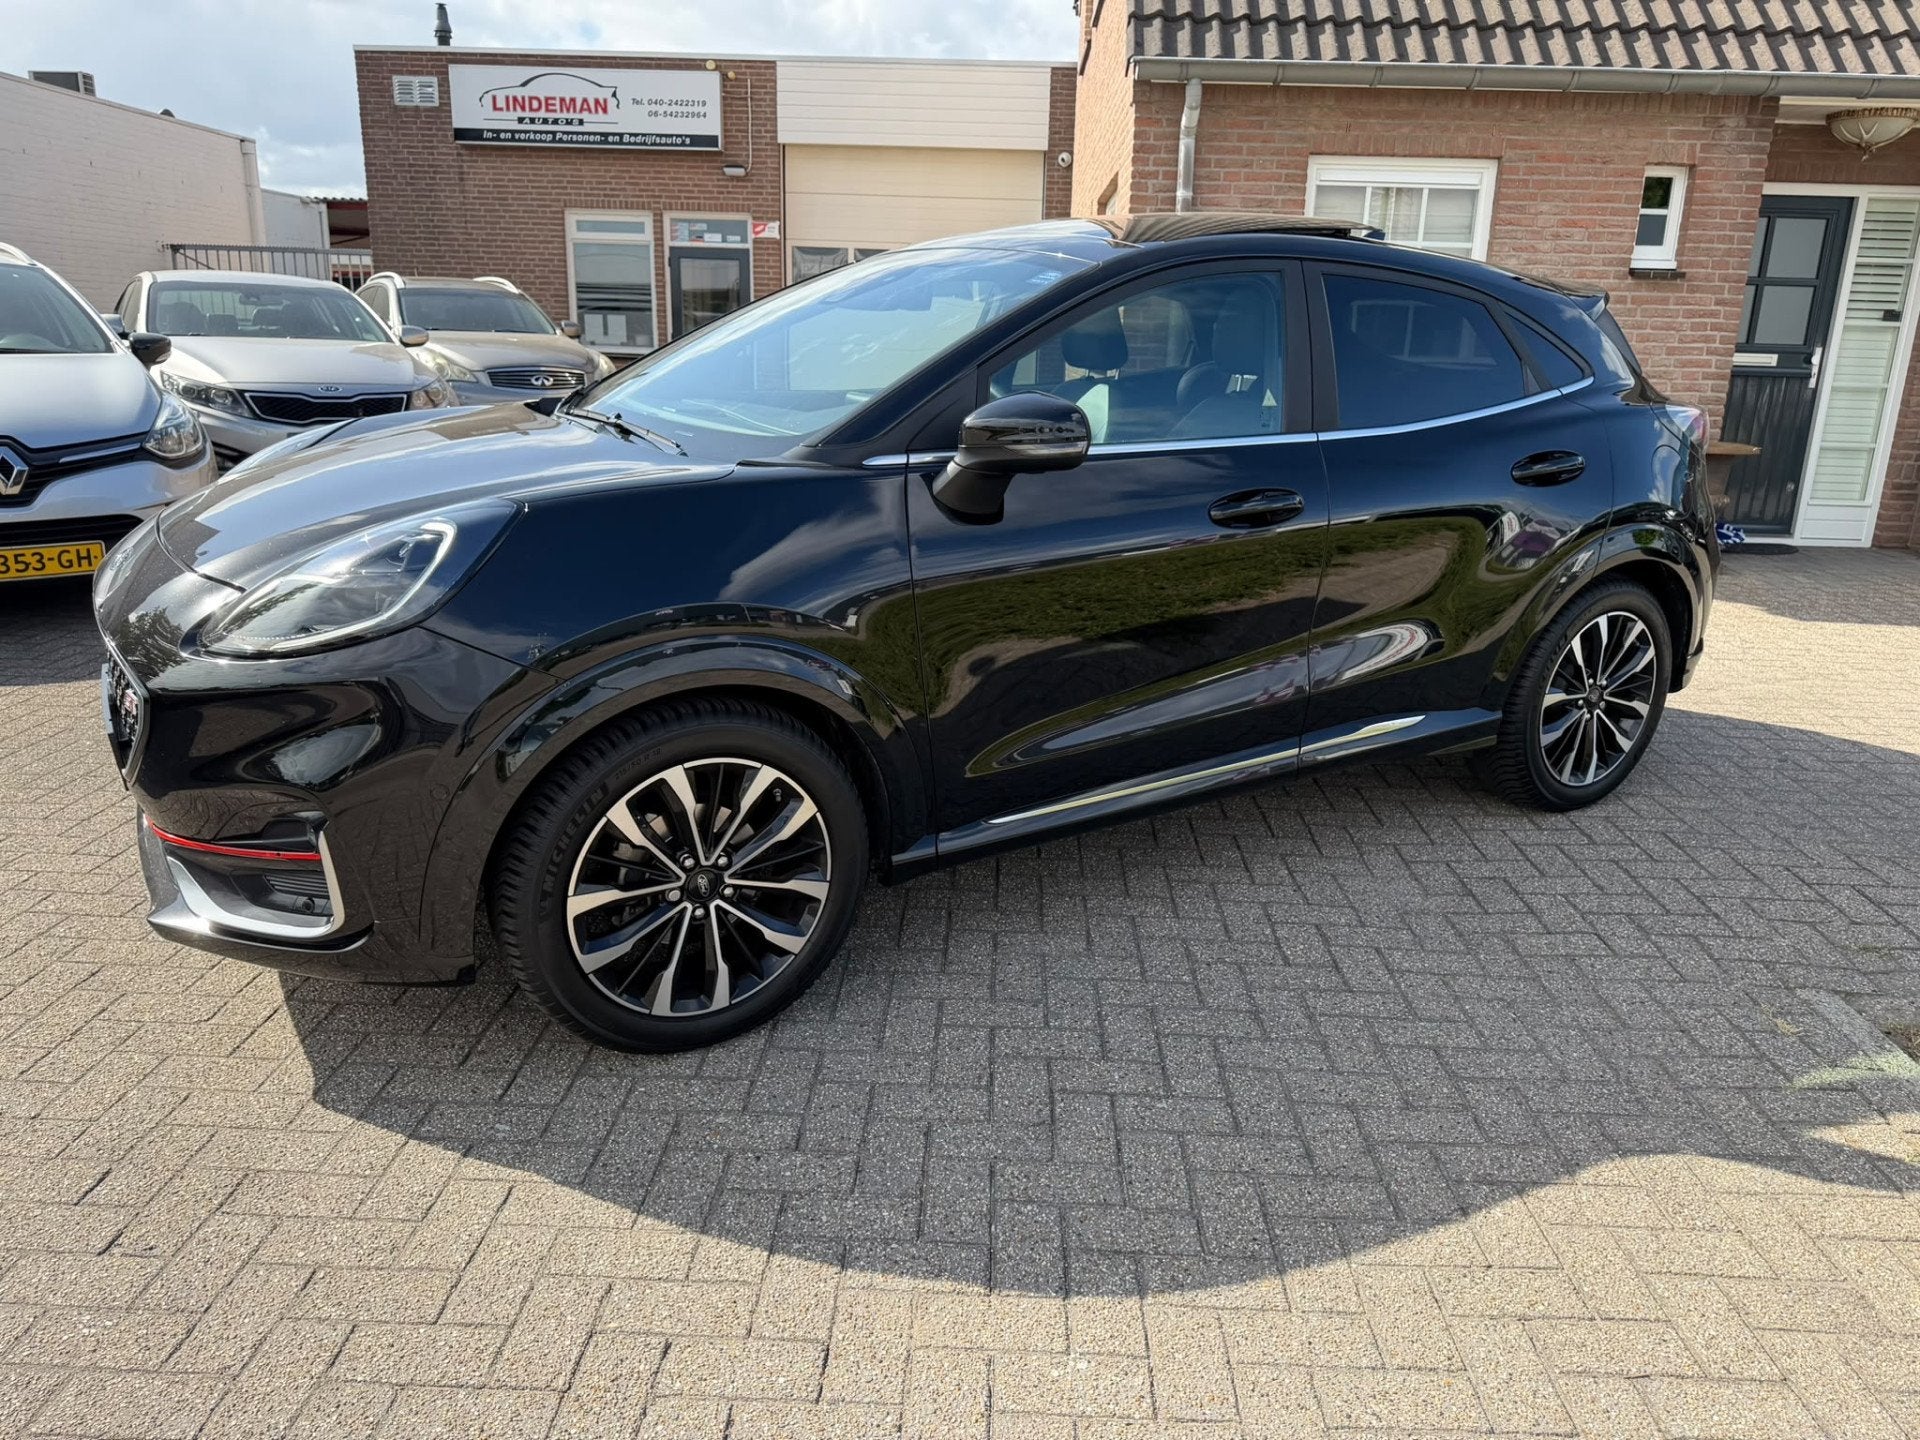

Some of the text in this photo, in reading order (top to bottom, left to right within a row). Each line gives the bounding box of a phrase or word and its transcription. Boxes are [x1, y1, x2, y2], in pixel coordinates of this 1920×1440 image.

[492, 95, 609, 115] LINDEMAN
[631, 98, 707, 107] Tel. 040-2422319
[647, 110, 707, 119] 06-54232964
[483, 130, 691, 145] In- en verkoop Personen- en Bedrijfsauto's
[542, 783, 605, 892] MICHELIN
